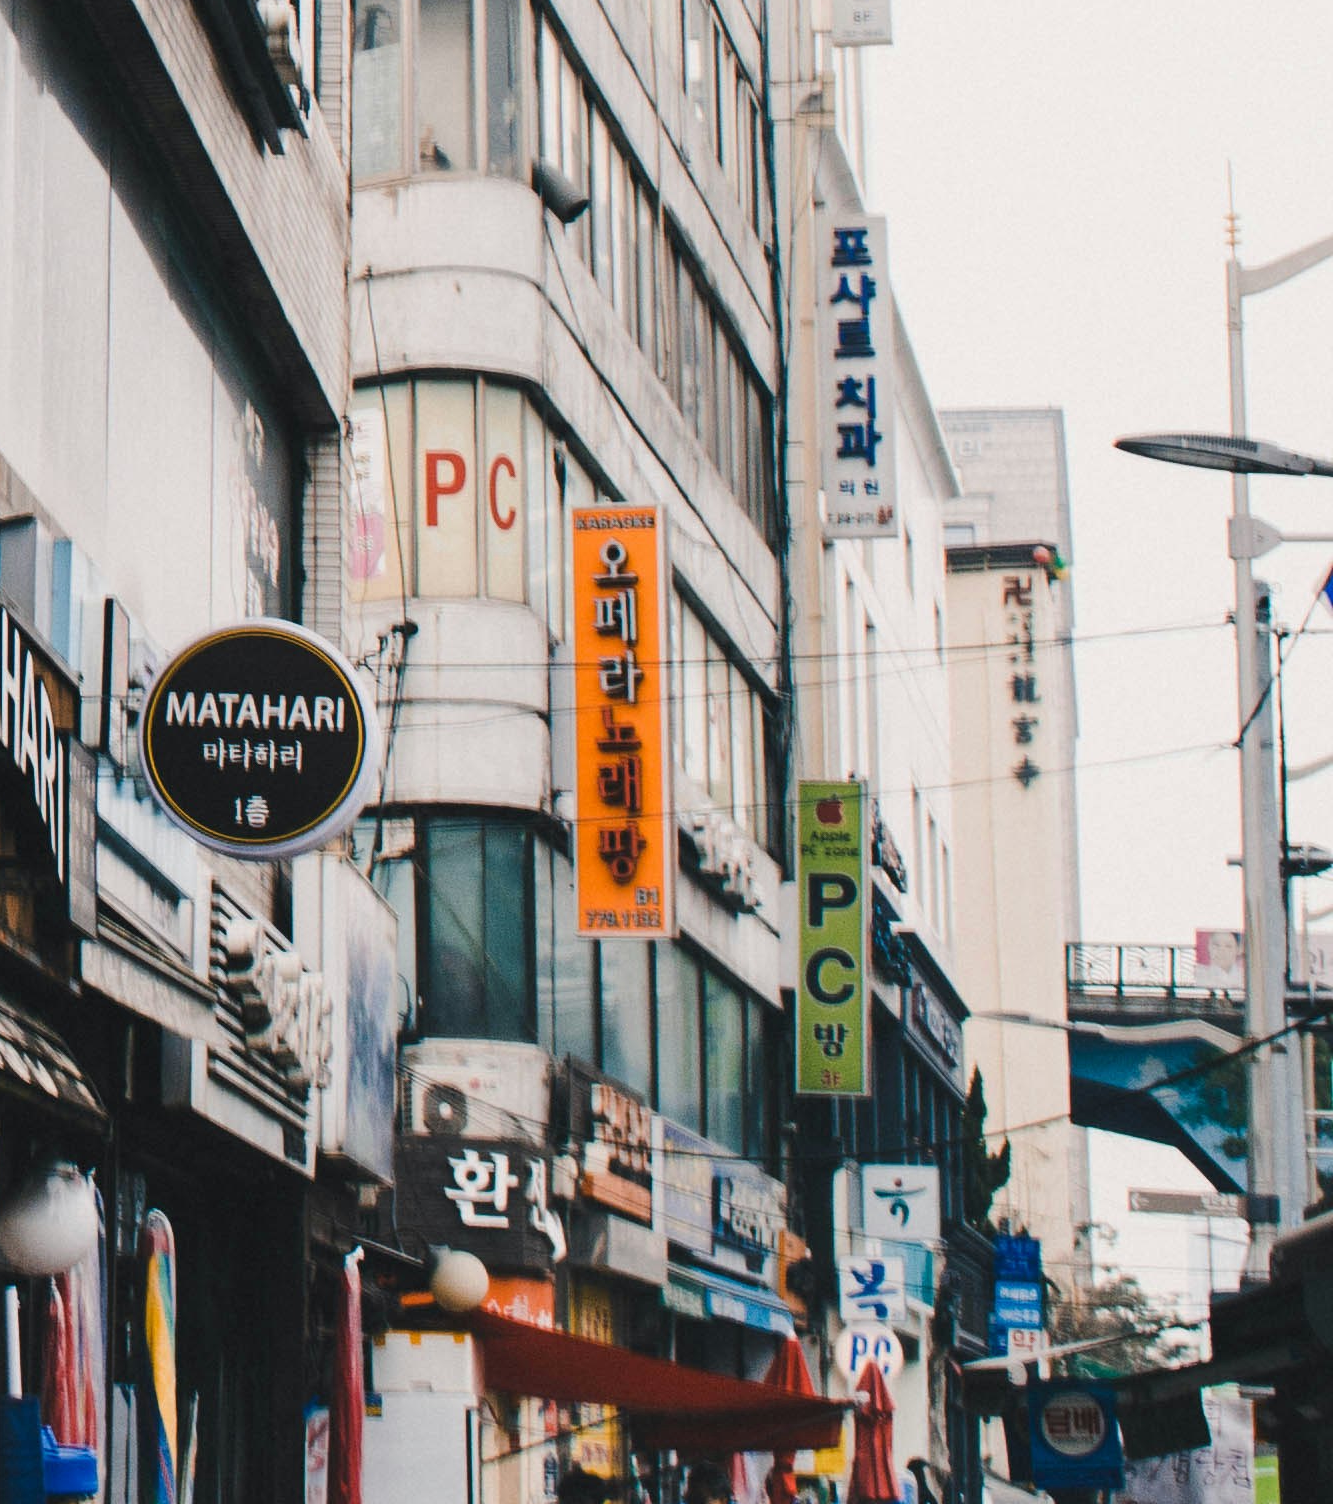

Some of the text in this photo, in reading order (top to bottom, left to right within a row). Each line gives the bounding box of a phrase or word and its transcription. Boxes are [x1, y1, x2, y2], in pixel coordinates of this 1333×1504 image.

[835, 374, 883, 468] 치과
[573, 515, 656, 532] KARAOKE
[165, 691, 345, 733] MATAHARI
[592, 538, 648, 888] 오페라 노래방
[202, 737, 303, 774] 마타하리
[235, 795, 270, 829] 1층
[809, 829, 852, 844] Apple
